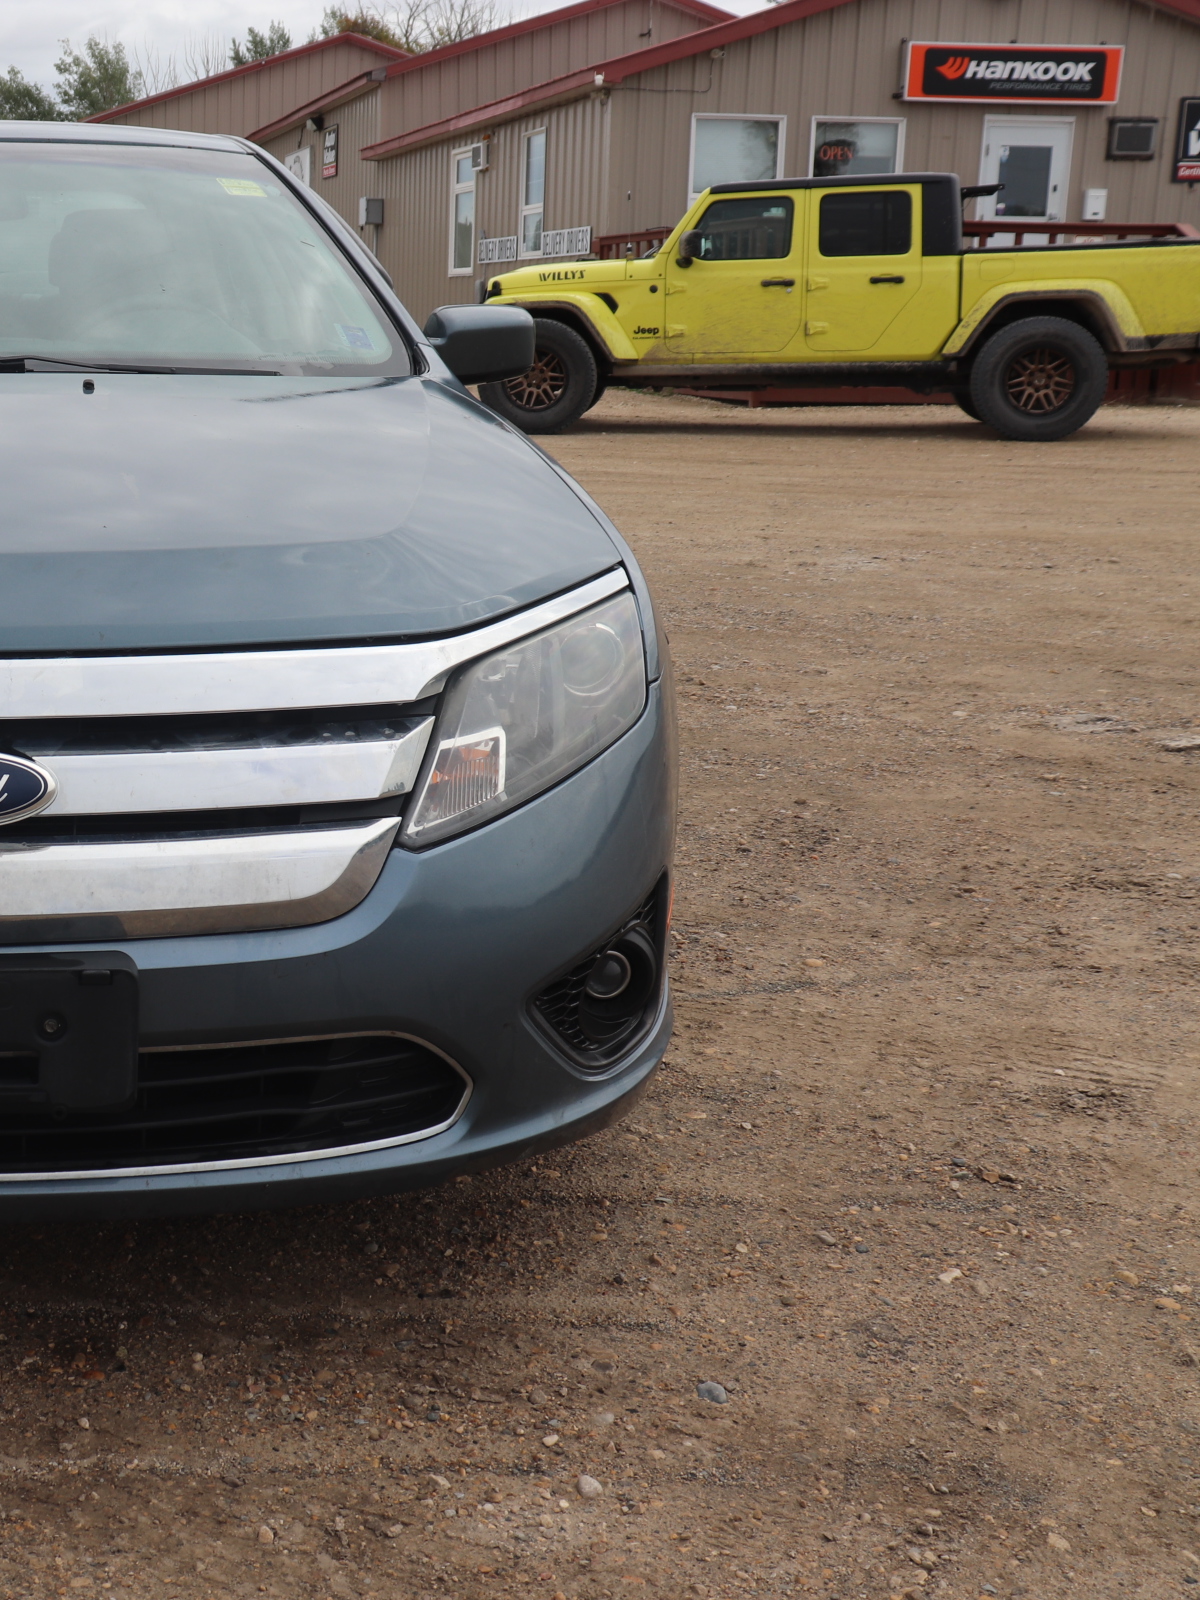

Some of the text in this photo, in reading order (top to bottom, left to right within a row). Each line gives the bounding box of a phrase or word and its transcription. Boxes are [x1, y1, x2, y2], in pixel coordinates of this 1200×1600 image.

[989, 82, 1092, 91] PERFORMANCE TIRES
[819, 145, 853, 160] OPEN
[539, 269, 586, 282] WILLYS
[633, 325, 660, 336] Jeep
